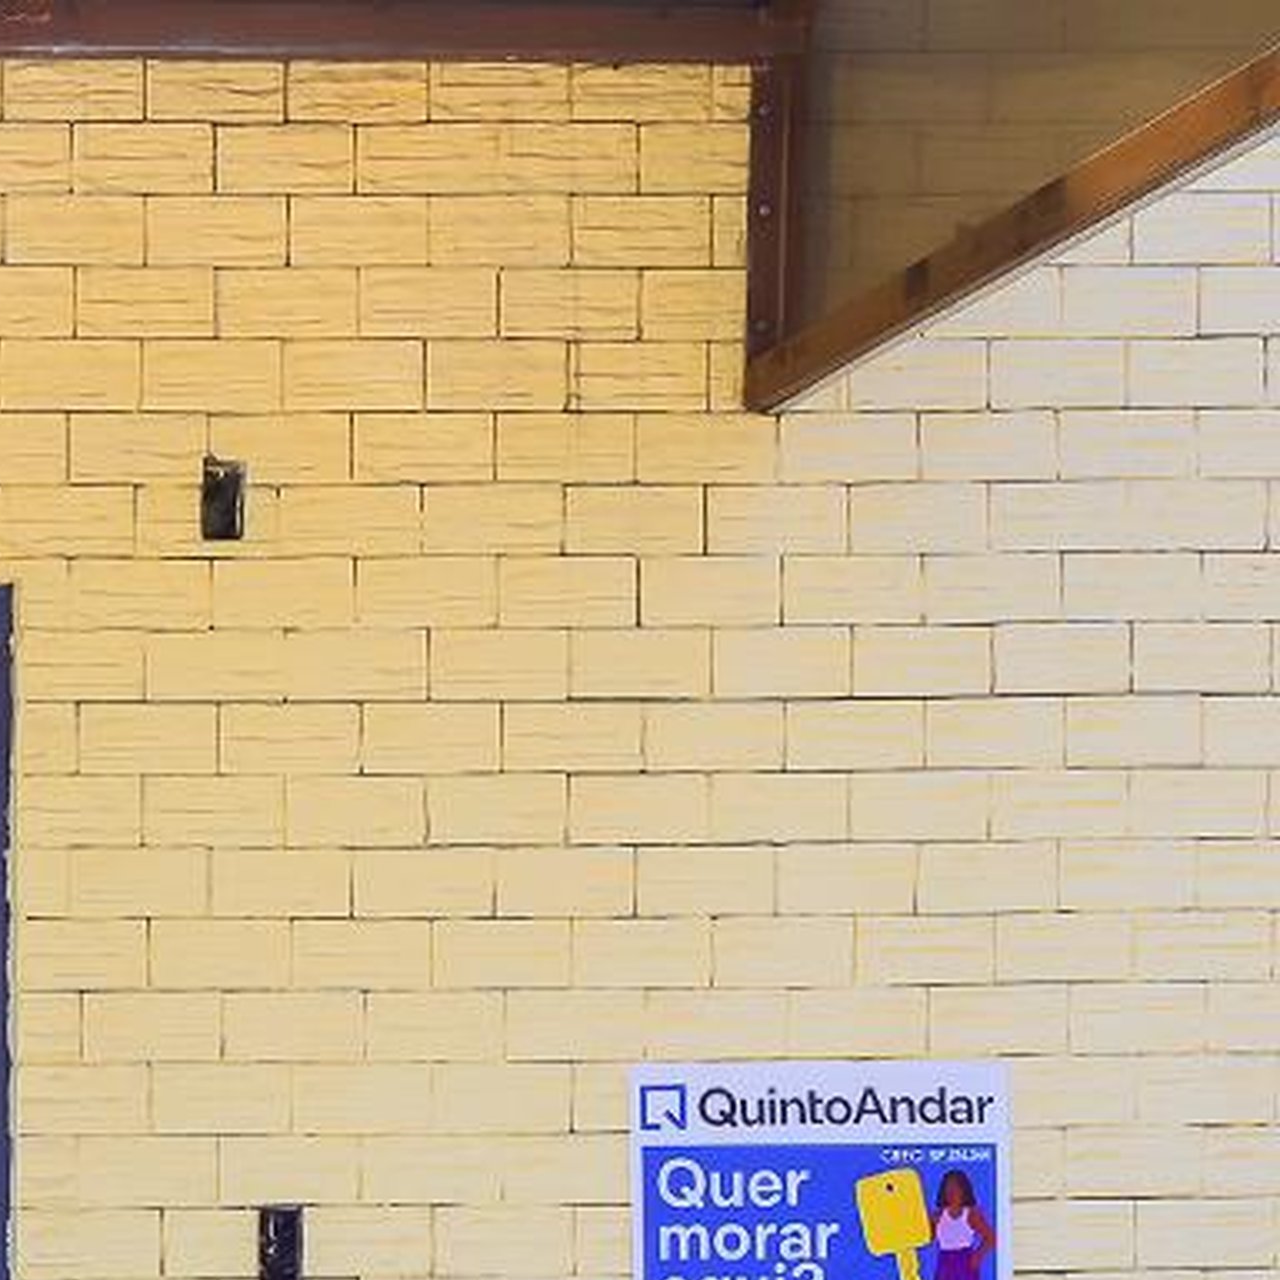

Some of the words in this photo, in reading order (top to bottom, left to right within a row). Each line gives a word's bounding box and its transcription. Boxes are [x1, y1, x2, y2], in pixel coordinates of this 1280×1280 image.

[697, 1086, 994, 1128] QuintoAndar
[657, 1158, 810, 1208] Quer
[657, 1221, 839, 1261] morar
